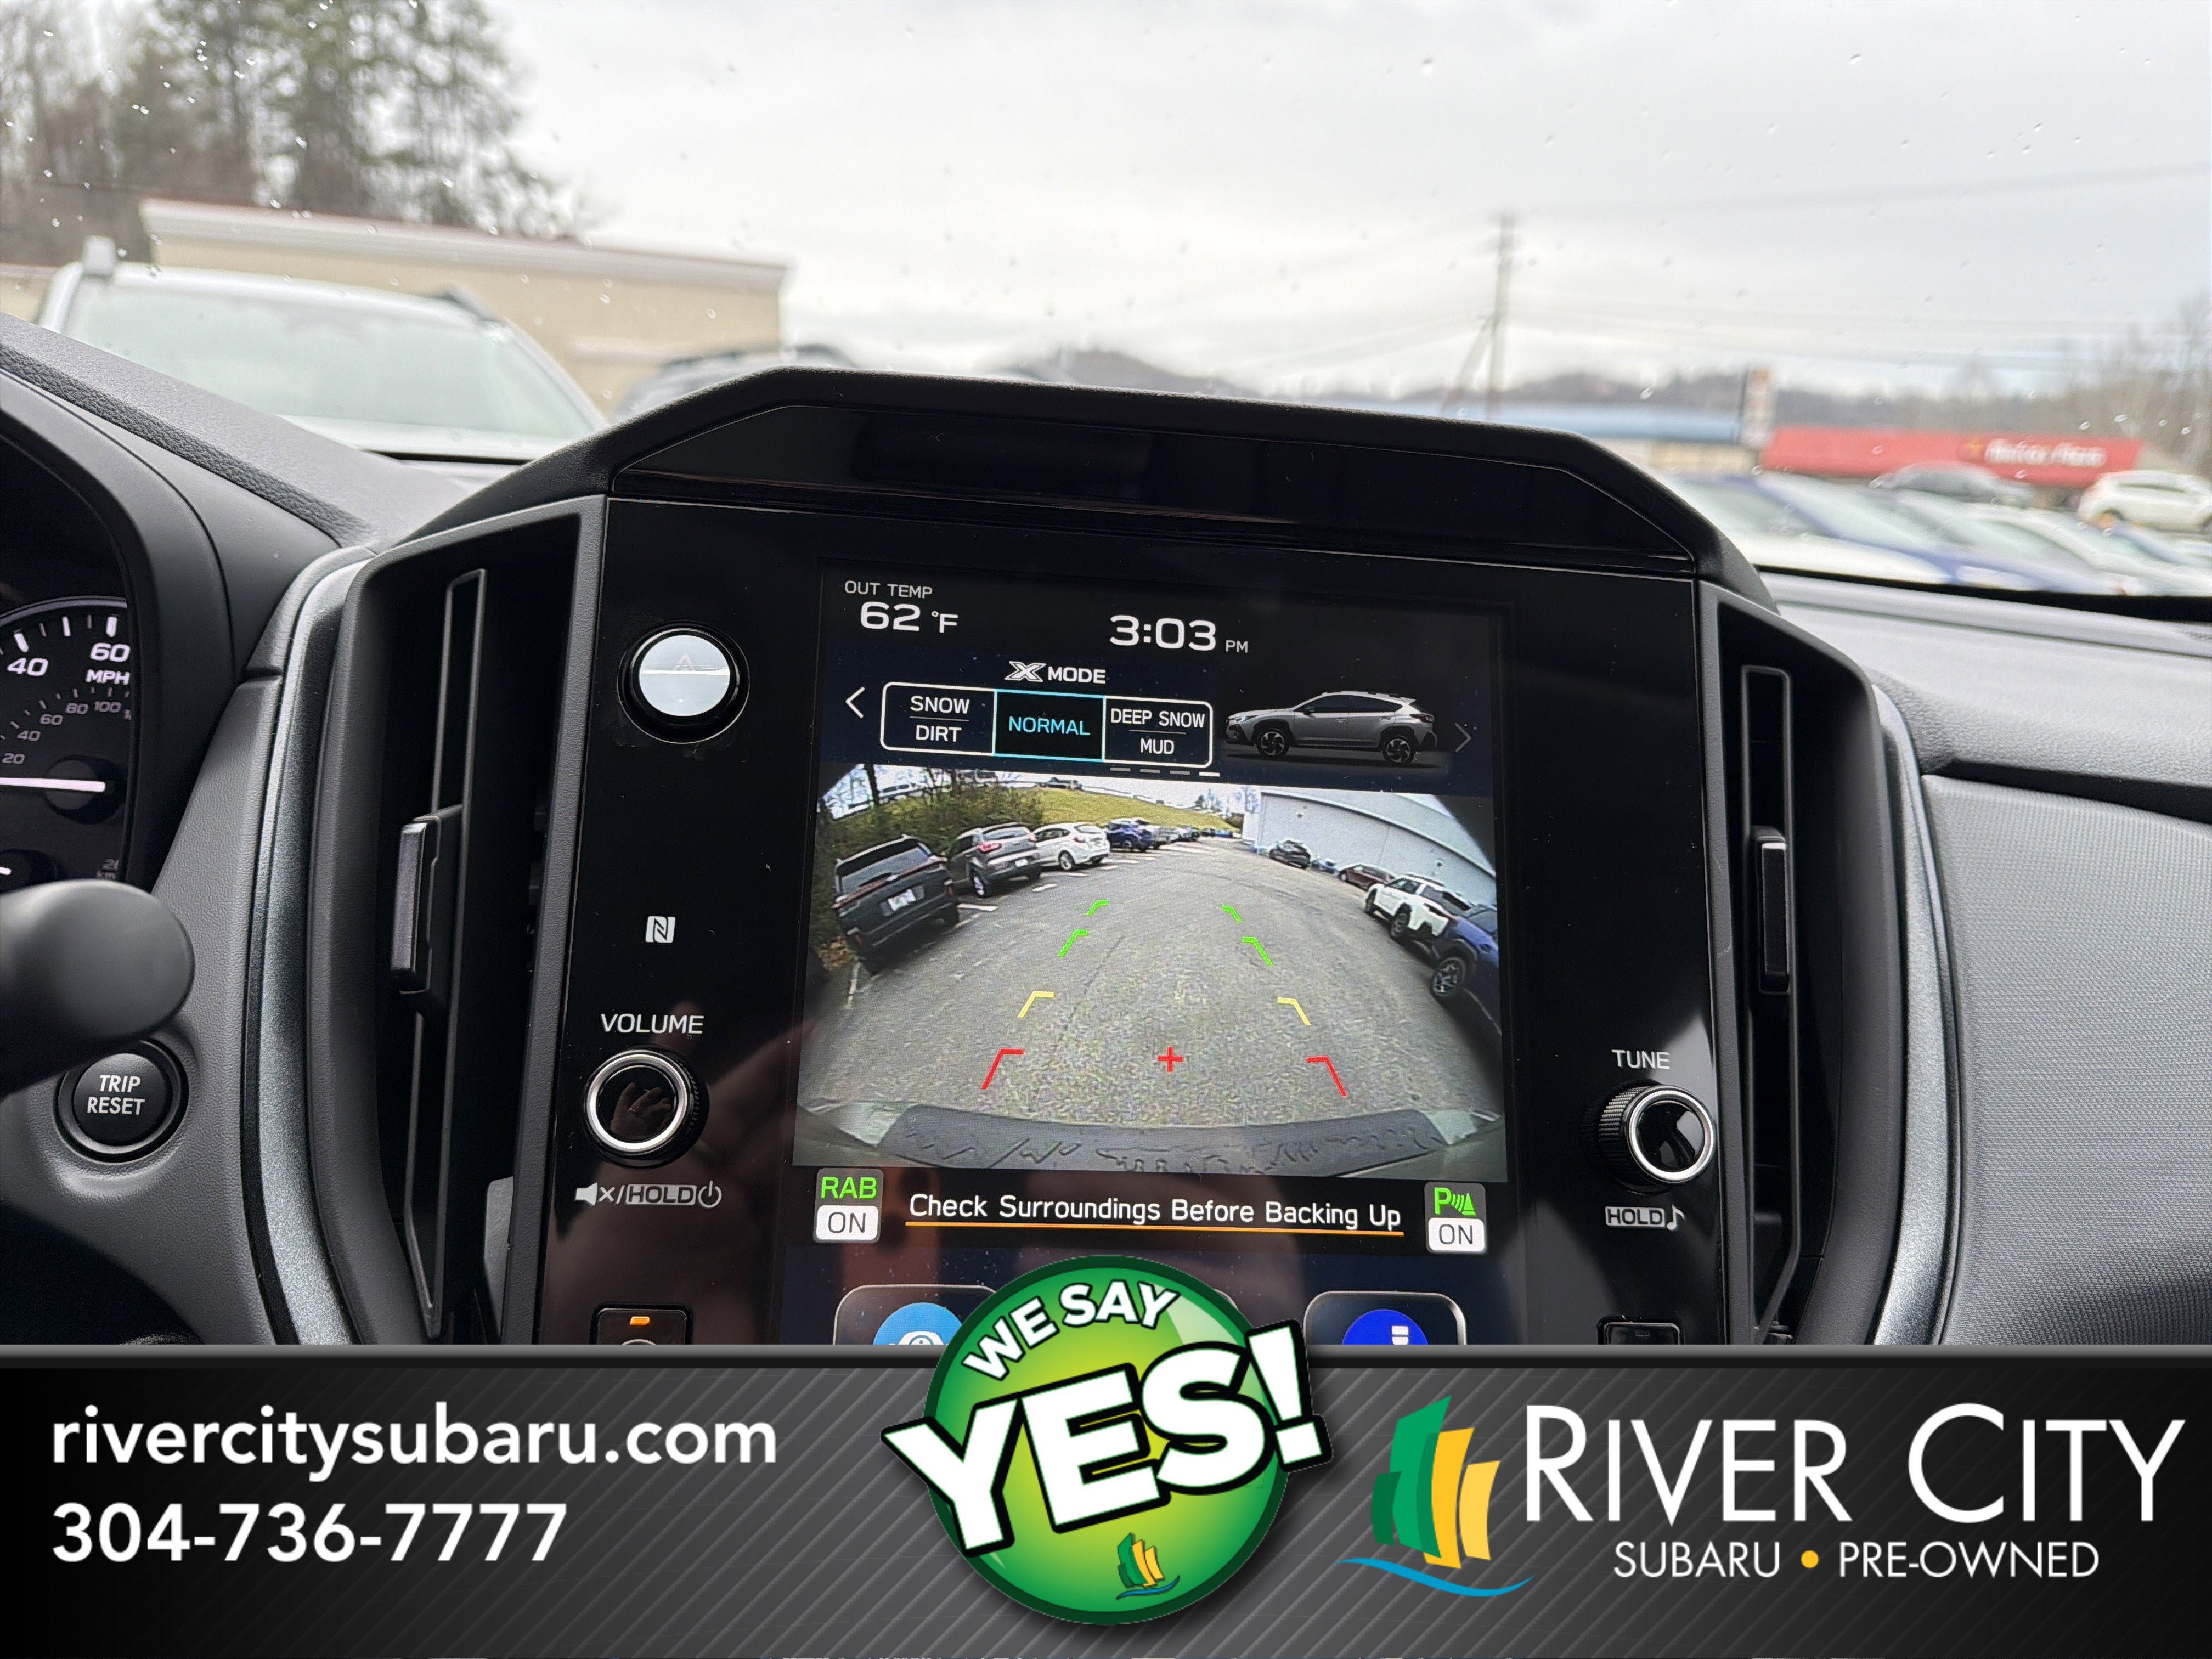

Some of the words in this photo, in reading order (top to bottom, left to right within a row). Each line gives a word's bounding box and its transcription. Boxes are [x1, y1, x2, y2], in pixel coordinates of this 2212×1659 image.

[845, 580, 881, 595] OUT
[887, 584, 933, 599] TEMP
[861, 601, 921, 631] 62
[1109, 614, 1216, 651] 3:03
[1226, 640, 1249, 653] PM
[90, 642, 131, 662] 60
[7, 658, 48, 676] 40
[86, 669, 131, 685] MPH
[65, 702, 89, 714] 80
[94, 701, 122, 713] 100
[910, 695, 970, 714] SNOW
[40, 714, 64, 726] 60
[1008, 715, 1091, 736] NORMAL
[1111, 708, 1153, 725] DEEP
[1159, 710, 1206, 728] SNOW
[17, 730, 41, 741] 40
[915, 725, 962, 742] DIRT
[1140, 738, 1175, 755] MUD
[2, 753, 25, 764] 20
[600, 1013, 705, 1034] VOLUME
[1611, 1049, 1671, 1070] TUNE
[99, 1074, 142, 1093] TRIP
[87, 1096, 146, 1115] RESET
[820, 1176, 878, 1200] RAB
[910, 1193, 988, 1217] Check
[999, 1194, 1161, 1225] Surroundings
[1171, 1199, 1255, 1223] Before
[1266, 1201, 1358, 1231] Backing
[1369, 1204, 1401, 1231] Up
[1607, 1207, 1664, 1225] HOLD
[828, 1211, 866, 1233] ON
[1438, 1224, 1474, 1245] ON
